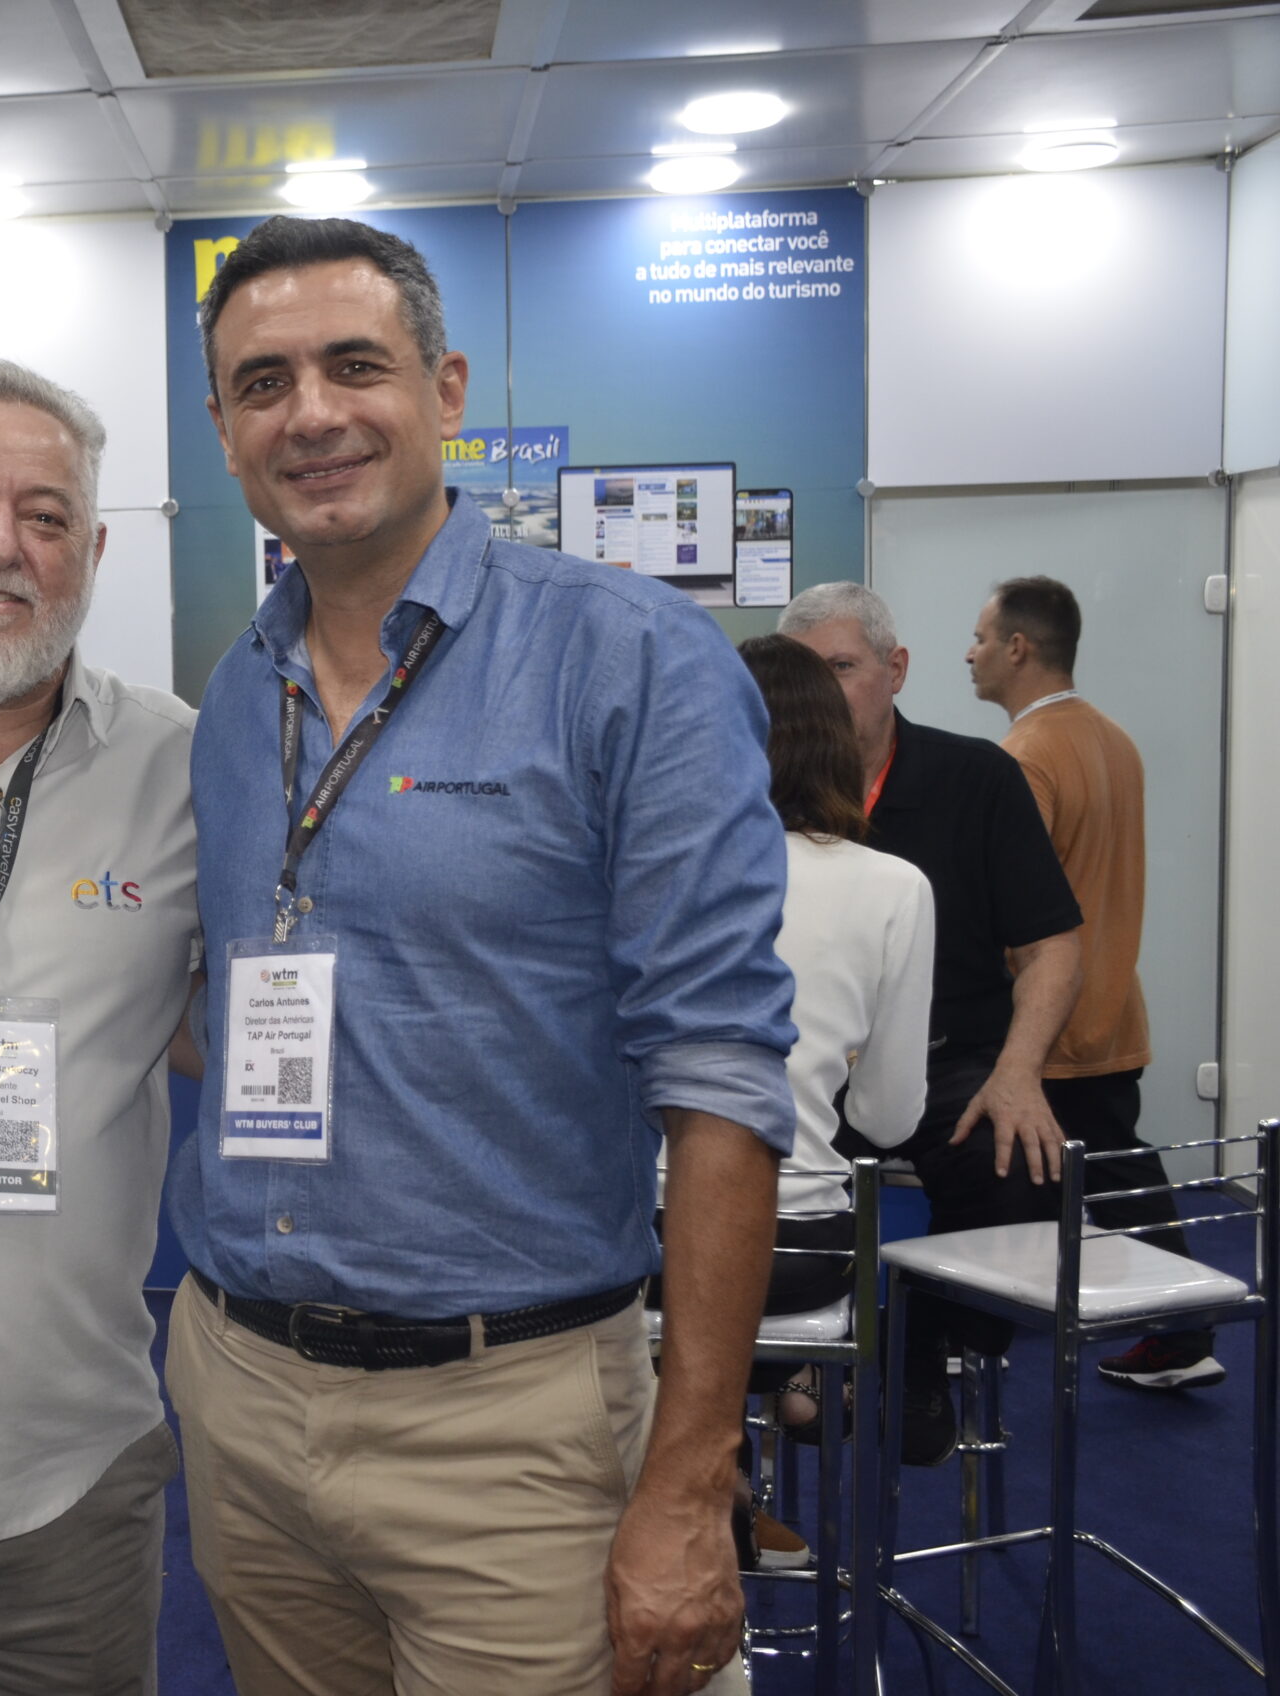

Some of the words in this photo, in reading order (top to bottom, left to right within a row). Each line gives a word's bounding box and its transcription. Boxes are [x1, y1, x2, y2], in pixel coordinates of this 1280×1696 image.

[671, 209, 818, 234] Multiplataforma
[660, 241, 702, 261] para
[705, 235, 784, 254] conectar
[787, 229, 829, 251] você
[635, 267, 647, 281] a
[650, 261, 691, 281] tudo
[694, 259, 717, 279] de
[720, 257, 765, 277] mais
[768, 255, 854, 275] relevante
[649, 288, 672, 304] no
[675, 283, 739, 303] mundo
[742, 281, 765, 300] do
[768, 280, 841, 299] turismo
[490, 434, 560, 464] Brasil
[314, 738, 364, 809] AIRPORTUGAL
[414, 782, 511, 796] AIRPORTUGAL
[70, 870, 144, 912] ets
[272, 968, 298, 980] wtm
[249, 998, 274, 1008] Carlos
[276, 997, 310, 1007] Antunes
[248, 1031, 263, 1041] TAP
[265, 1031, 276, 1041] Air
[278, 1029, 311, 1042] Portugal
[11, 1095, 37, 1105] Shop
[234, 1119, 254, 1129] WTM
[293, 1120, 318, 1130] CLUB
